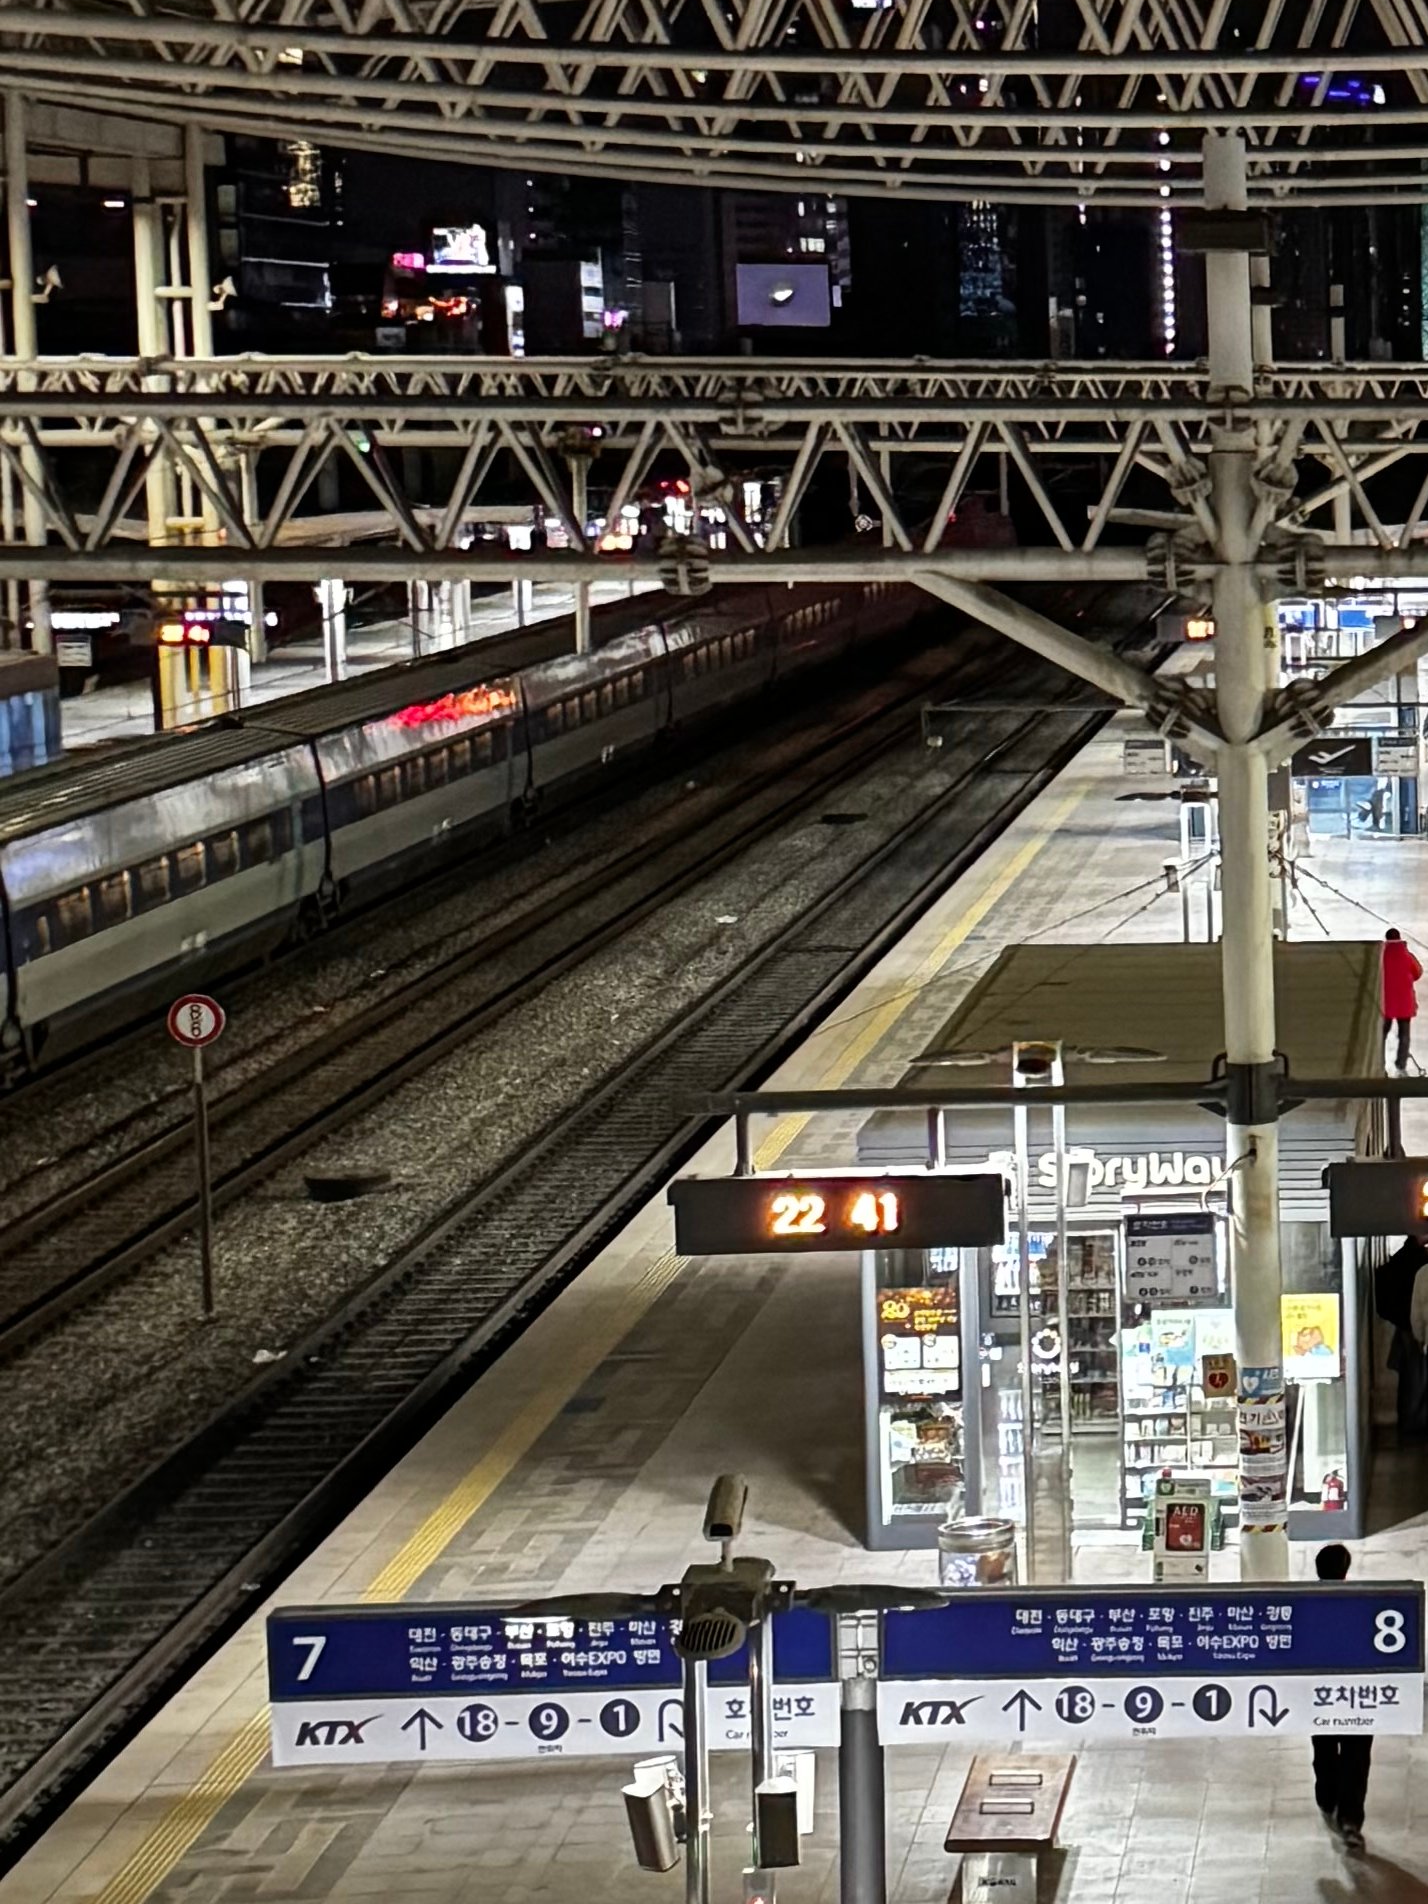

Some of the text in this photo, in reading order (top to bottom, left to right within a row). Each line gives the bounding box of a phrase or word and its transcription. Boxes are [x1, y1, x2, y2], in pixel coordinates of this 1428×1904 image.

[1038, 1151, 1228, 1189] SryWay
[769, 1191, 899, 1235] 22 41
[1373, 1609, 1406, 1653] 8
[292, 1636, 327, 1681] 7
[725, 1696, 816, 1722] 호번호
[899, 1695, 986, 1726] KTX
[1061, 1691, 1093, 1720] 18
[1313, 1684, 1400, 1709] 호차번호
[295, 1713, 384, 1747] KTX
[462, 1709, 495, 1737] 18
